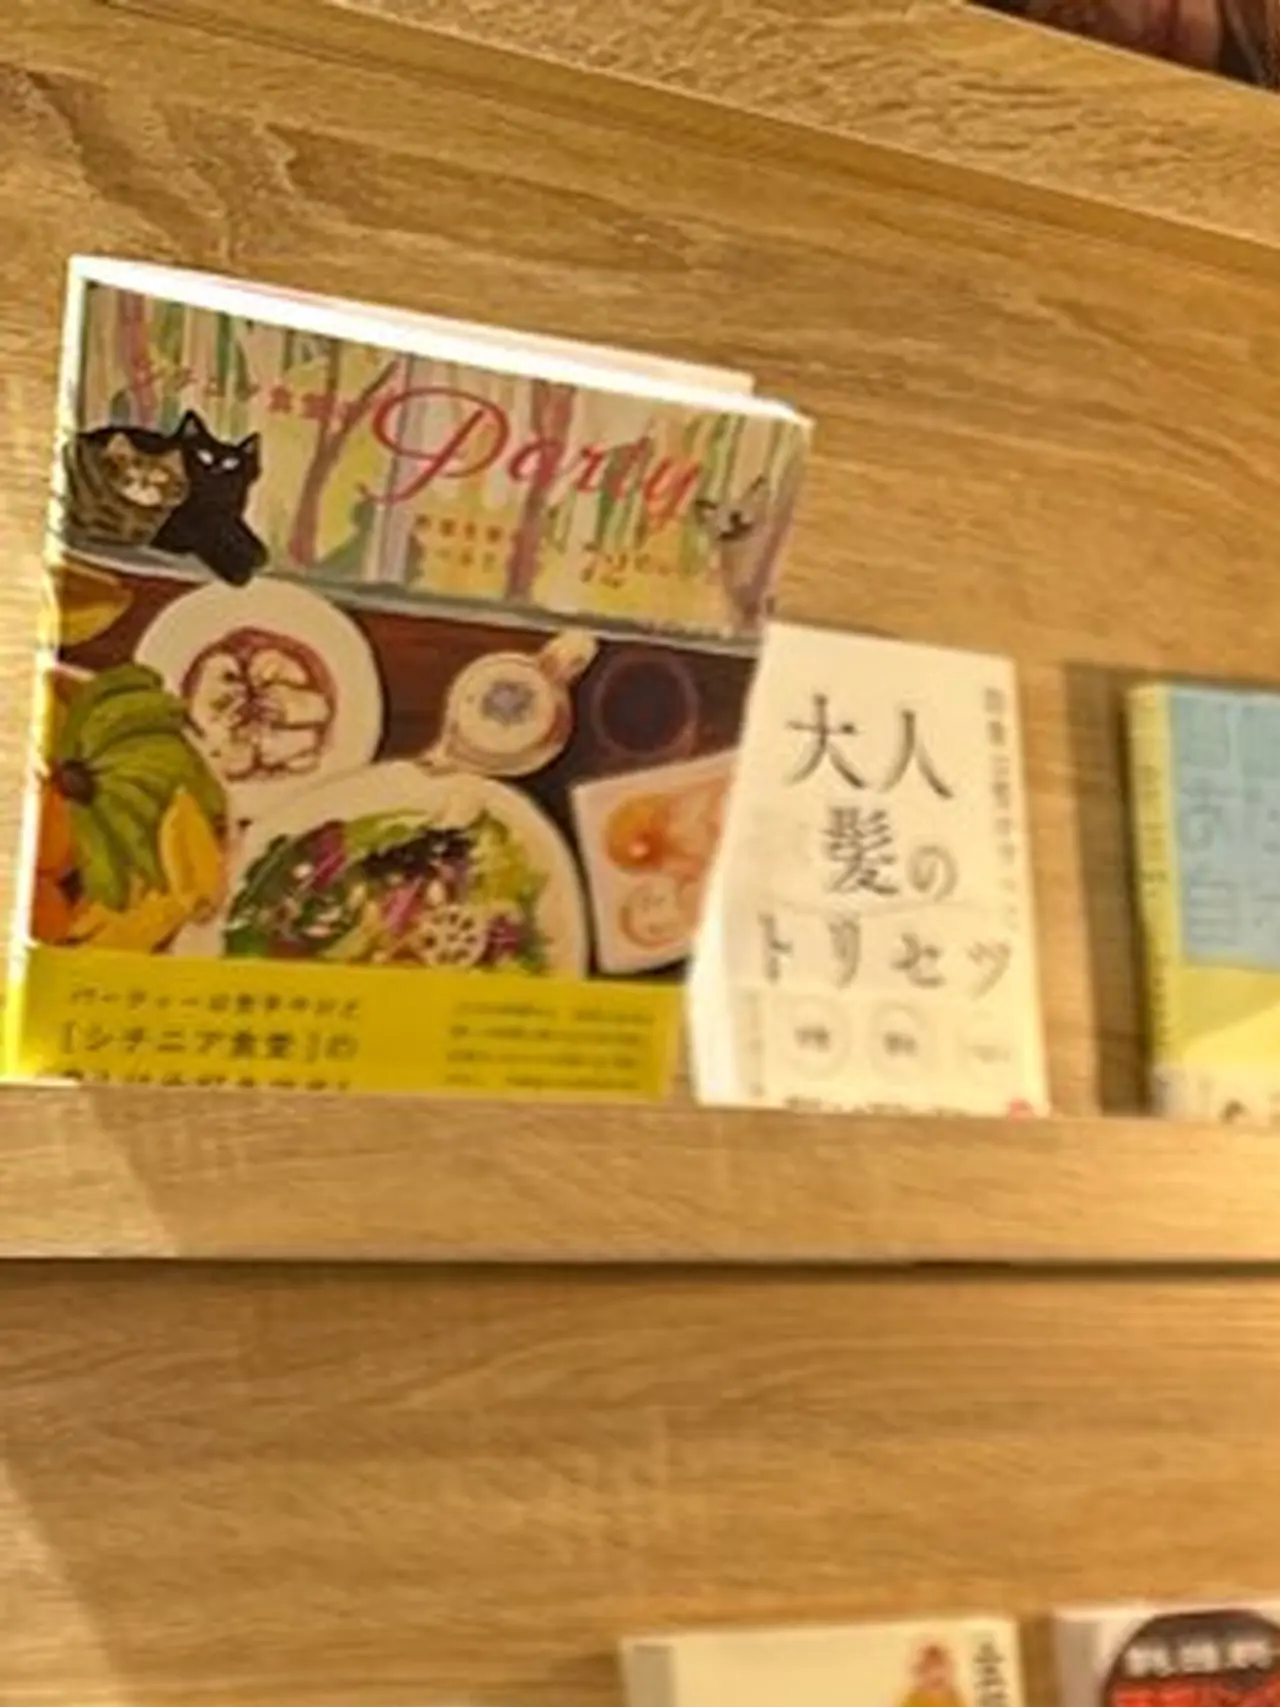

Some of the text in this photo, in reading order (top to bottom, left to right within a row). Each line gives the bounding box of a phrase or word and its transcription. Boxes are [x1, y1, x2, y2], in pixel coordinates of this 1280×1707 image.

[358, 385, 702, 538] Party
[782, 693, 954, 799] 大人
[820, 804, 960, 902] 髪の
[757, 912, 1014, 1001] トリセツ
